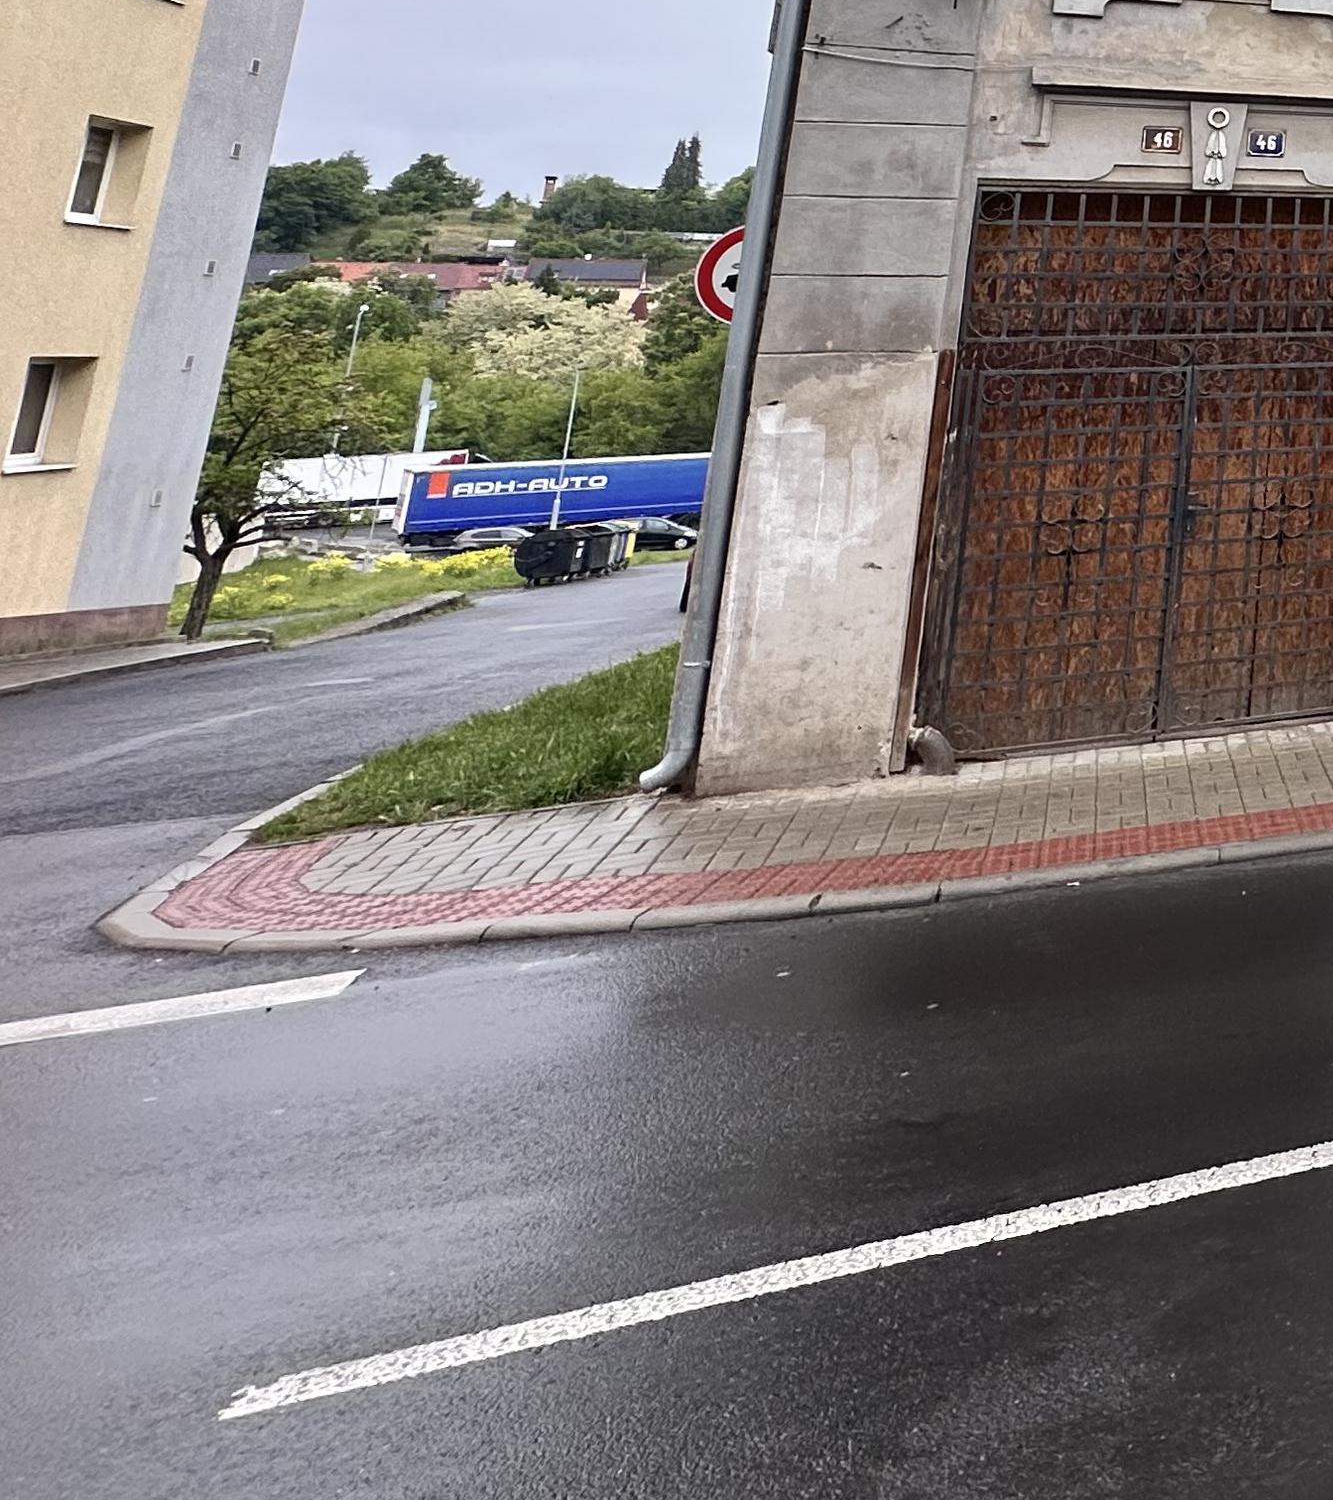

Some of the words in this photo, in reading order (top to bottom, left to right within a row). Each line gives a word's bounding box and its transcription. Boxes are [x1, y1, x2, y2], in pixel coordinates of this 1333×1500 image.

[1153, 131, 1174, 149] 46
[1256, 134, 1277, 151] 46
[452, 475, 608, 496] ADH-AUTO
